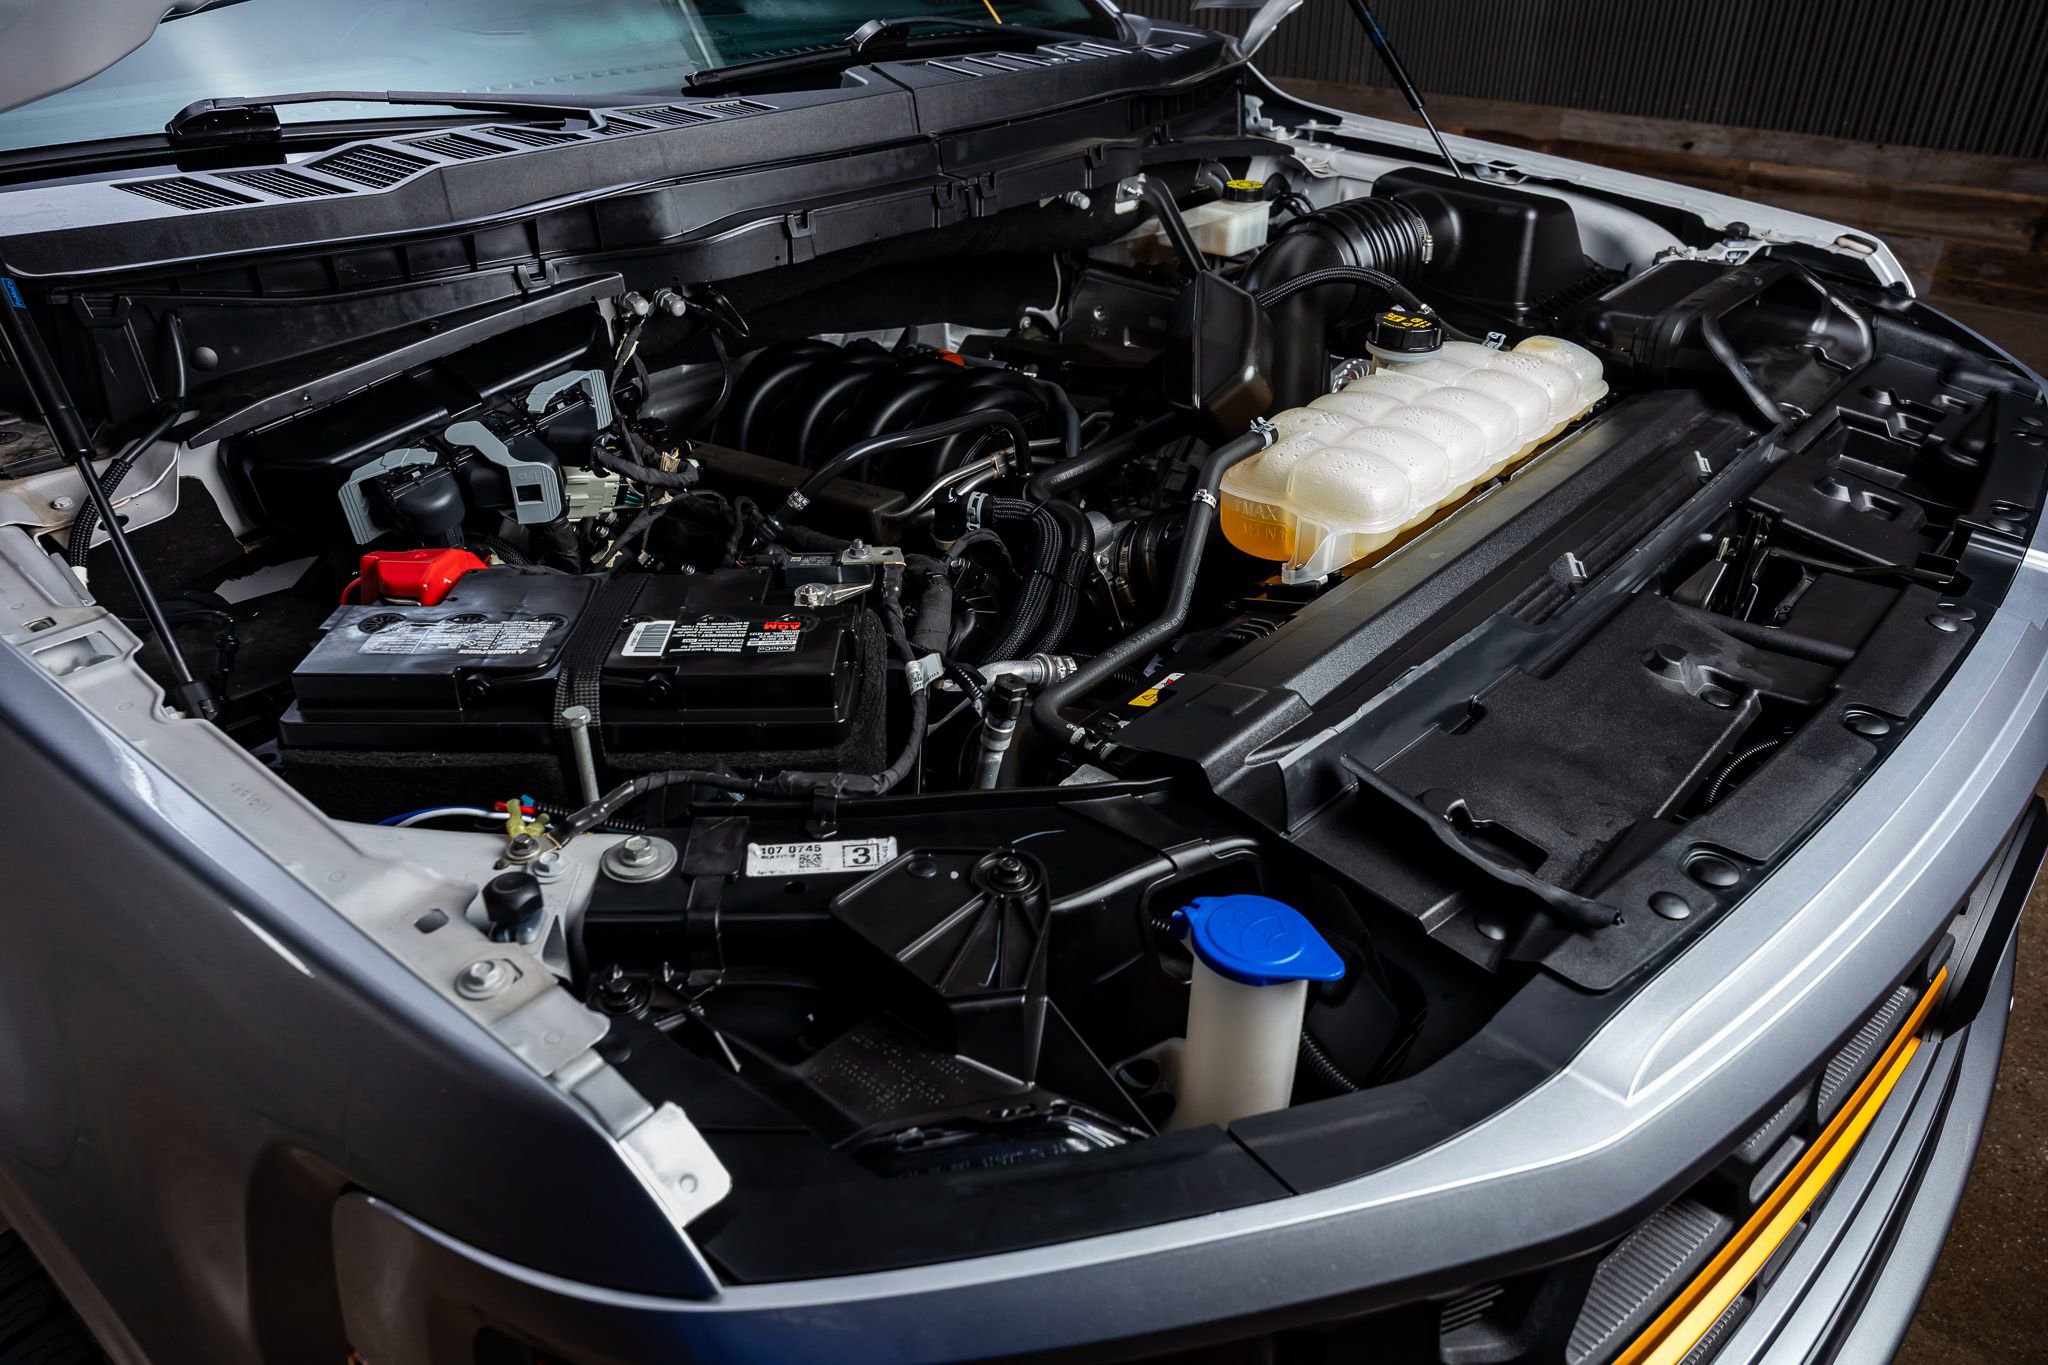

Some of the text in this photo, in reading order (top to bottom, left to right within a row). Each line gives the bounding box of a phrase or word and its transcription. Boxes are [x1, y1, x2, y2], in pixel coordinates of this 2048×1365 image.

[1242, 502, 1277, 521] MAX
[1242, 522, 1276, 543] MIN
[760, 845, 821, 855] 107 0745
[852, 847, 871, 865] 3
